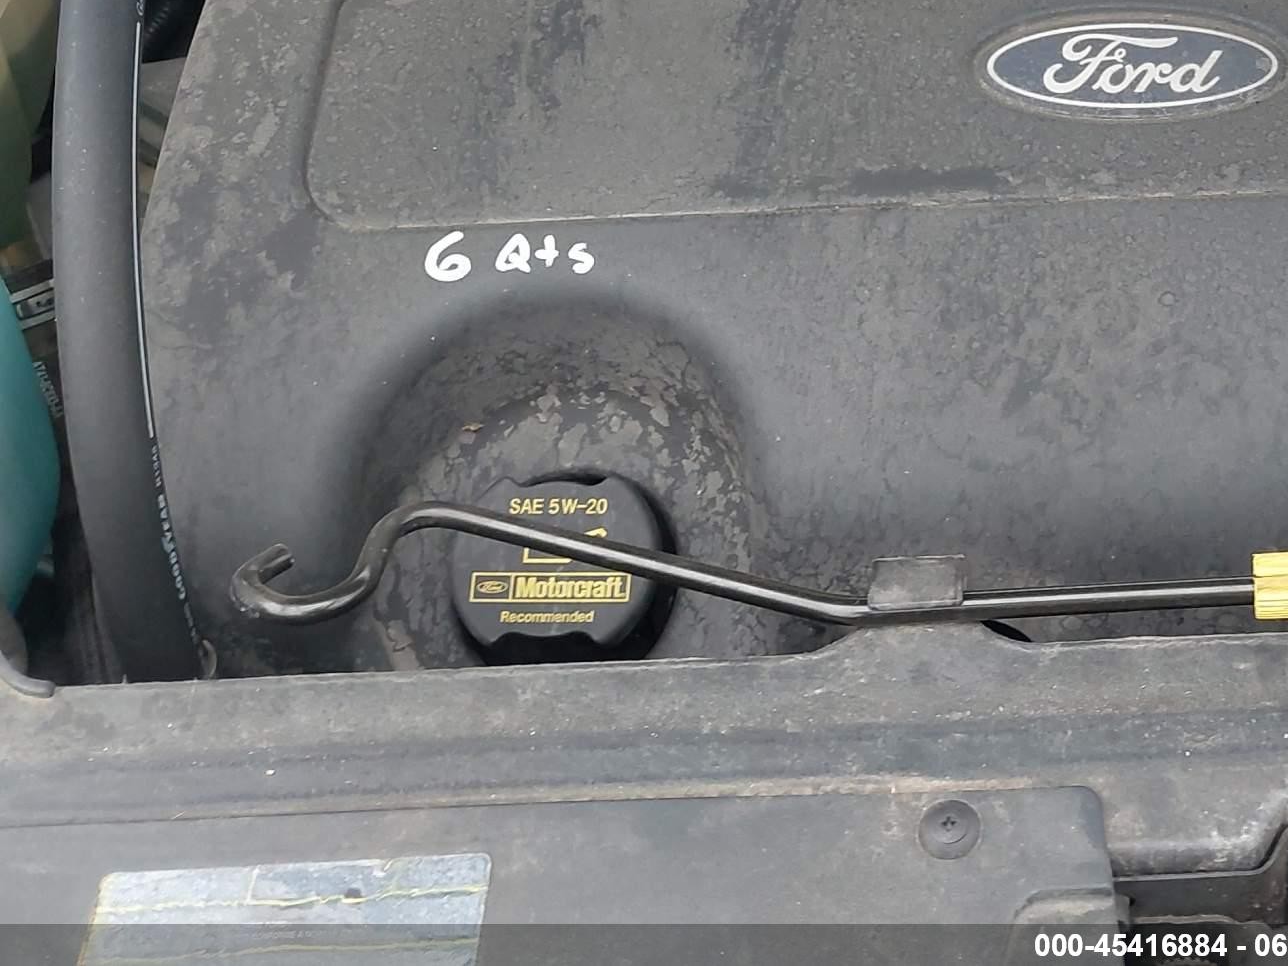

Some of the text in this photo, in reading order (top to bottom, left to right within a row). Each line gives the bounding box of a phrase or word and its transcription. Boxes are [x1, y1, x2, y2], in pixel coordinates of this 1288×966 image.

[1043, 33, 1223, 94] Ford
[424, 230, 595, 282] 6 Qts
[509, 498, 609, 515] SAE 5W-20
[514, 576, 627, 599] Motorcraft
[500, 610, 595, 624] Recommended
